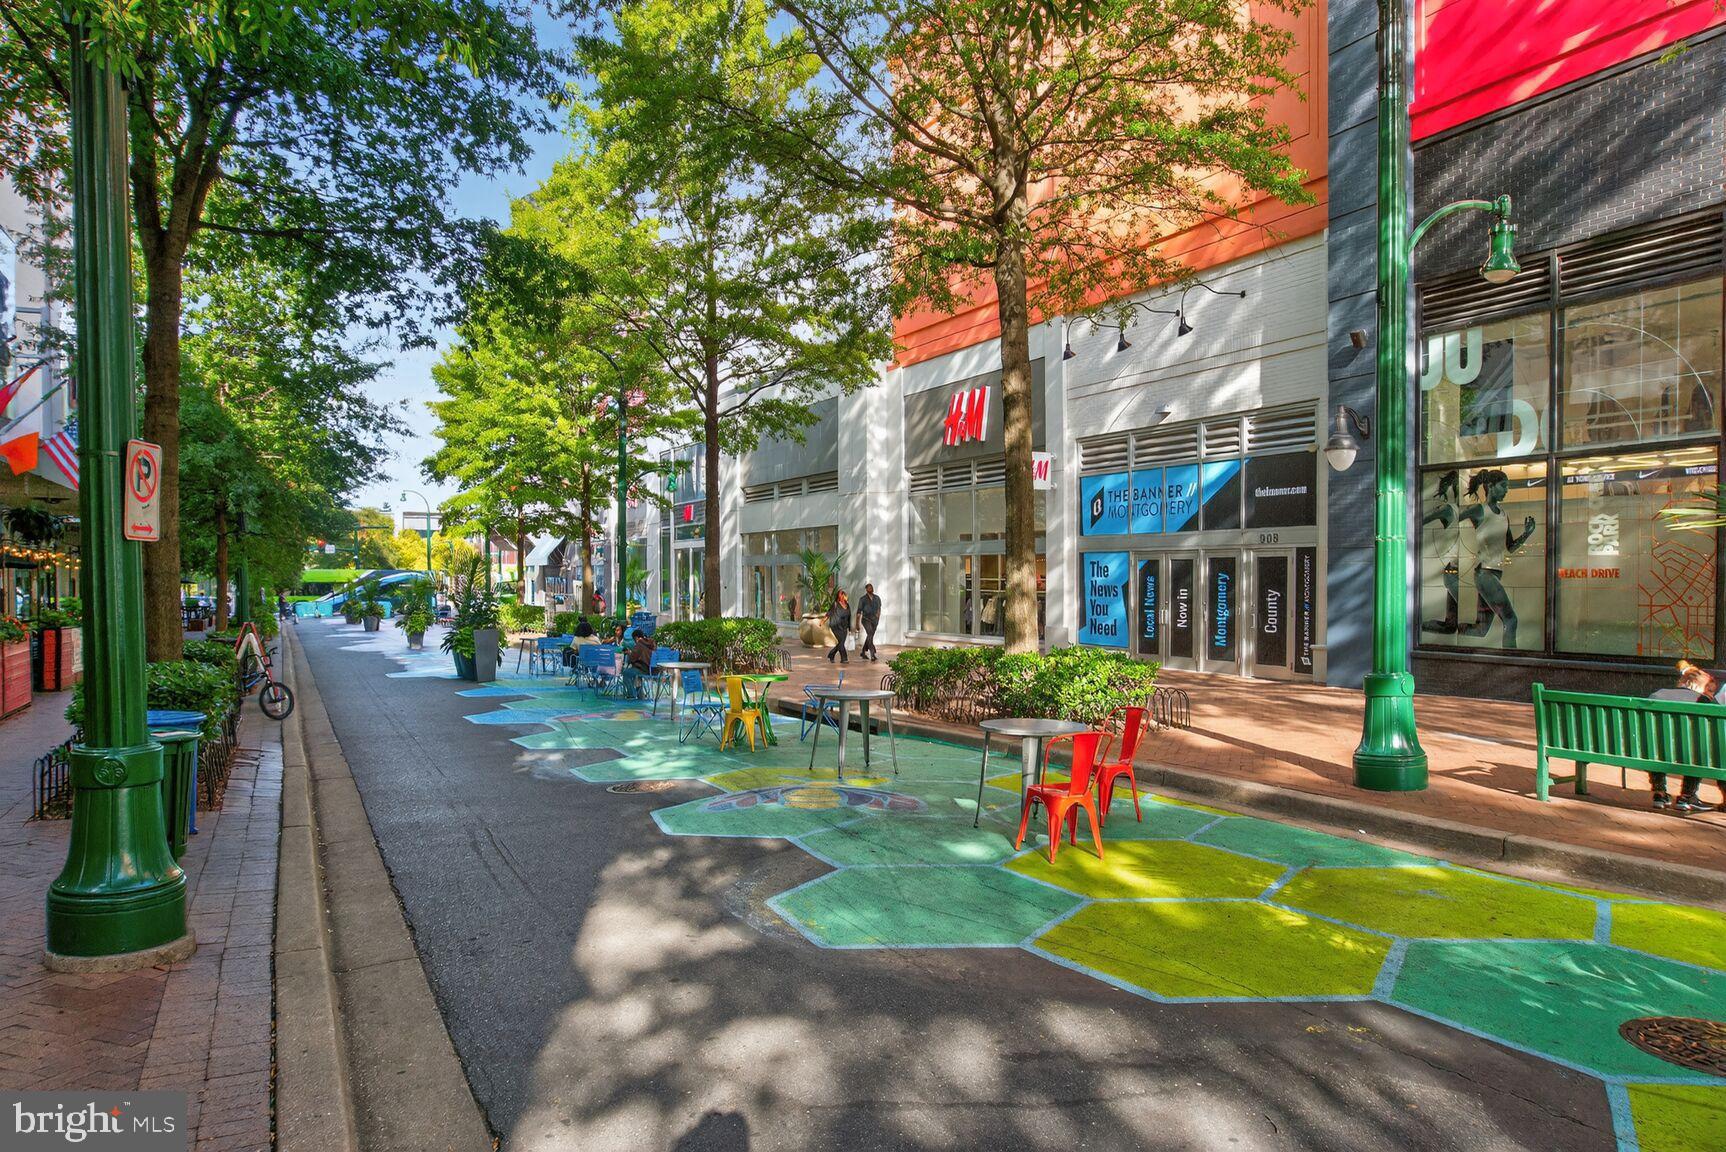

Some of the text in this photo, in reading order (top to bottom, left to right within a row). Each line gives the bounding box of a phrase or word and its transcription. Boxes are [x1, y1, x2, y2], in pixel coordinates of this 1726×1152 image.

[943, 384, 991, 447] H&M
[1107, 489, 1128, 503] THE
[1133, 484, 1183, 501] BANNER
[1260, 533, 1279, 543] 908
[1090, 560, 1109, 578] The
[1591, 568, 1620, 578] DRIVE
[1090, 580, 1118, 597] News
[1089, 599, 1109, 617] You
[1144, 575, 1155, 638] Local News
[1177, 588, 1188, 628] Now in
[1215, 573, 1230, 647] Montgomery
[1264, 589, 1281, 634] County
[1090, 618, 1117, 636] Need
